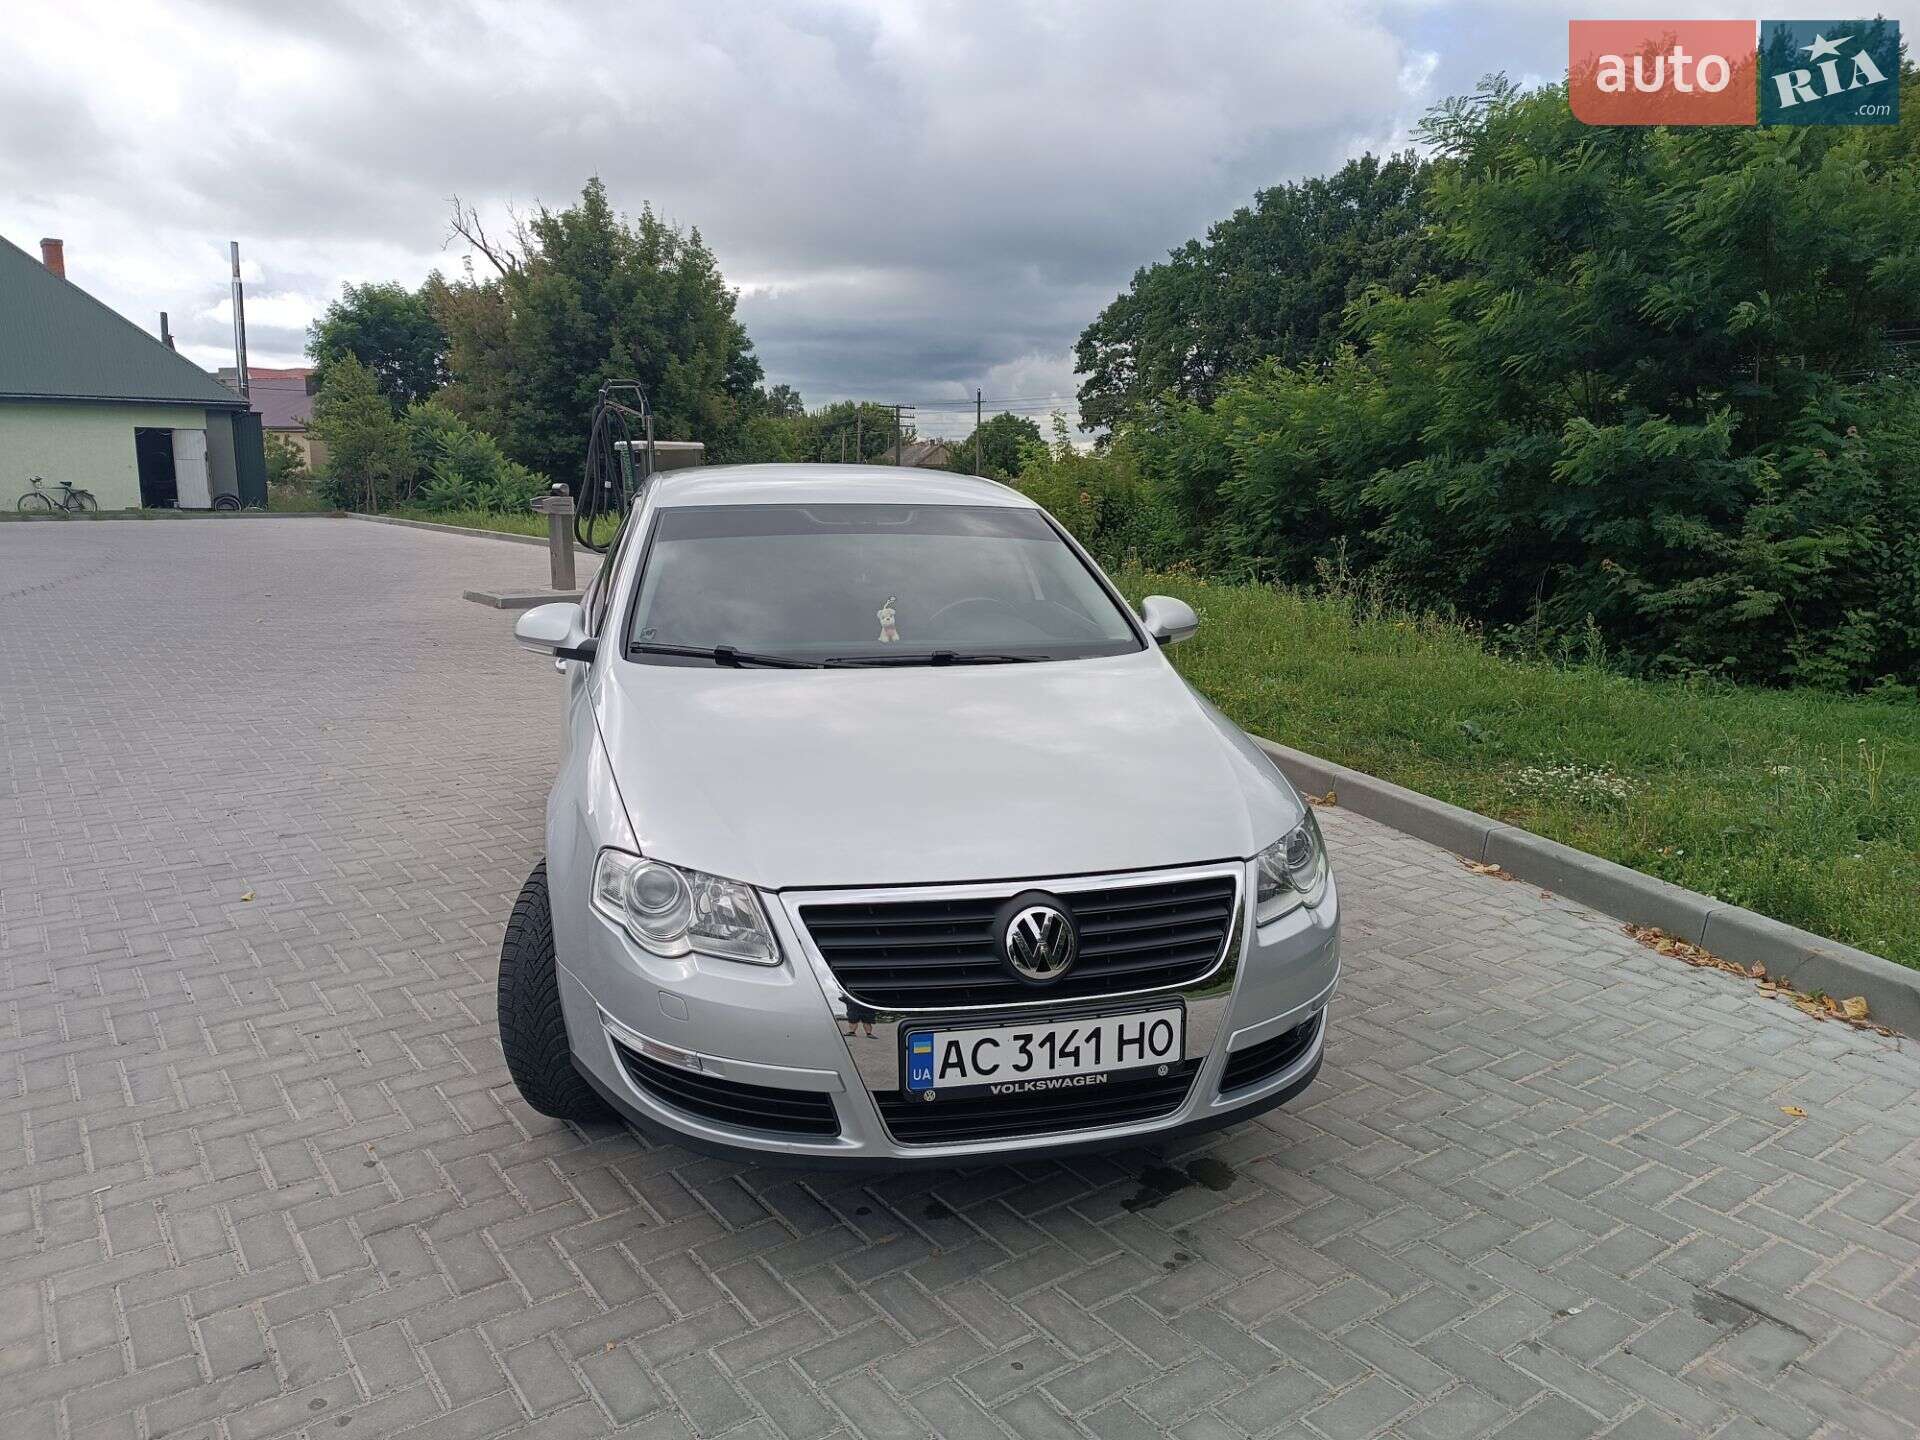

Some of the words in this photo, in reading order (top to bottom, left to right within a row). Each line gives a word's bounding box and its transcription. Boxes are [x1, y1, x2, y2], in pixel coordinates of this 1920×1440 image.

[938, 1037, 1000, 1079] AC
[1011, 1026, 1102, 1073] 3141
[912, 1069, 932, 1081] UA
[991, 1073, 1108, 1095] VOLKSWAGEN
